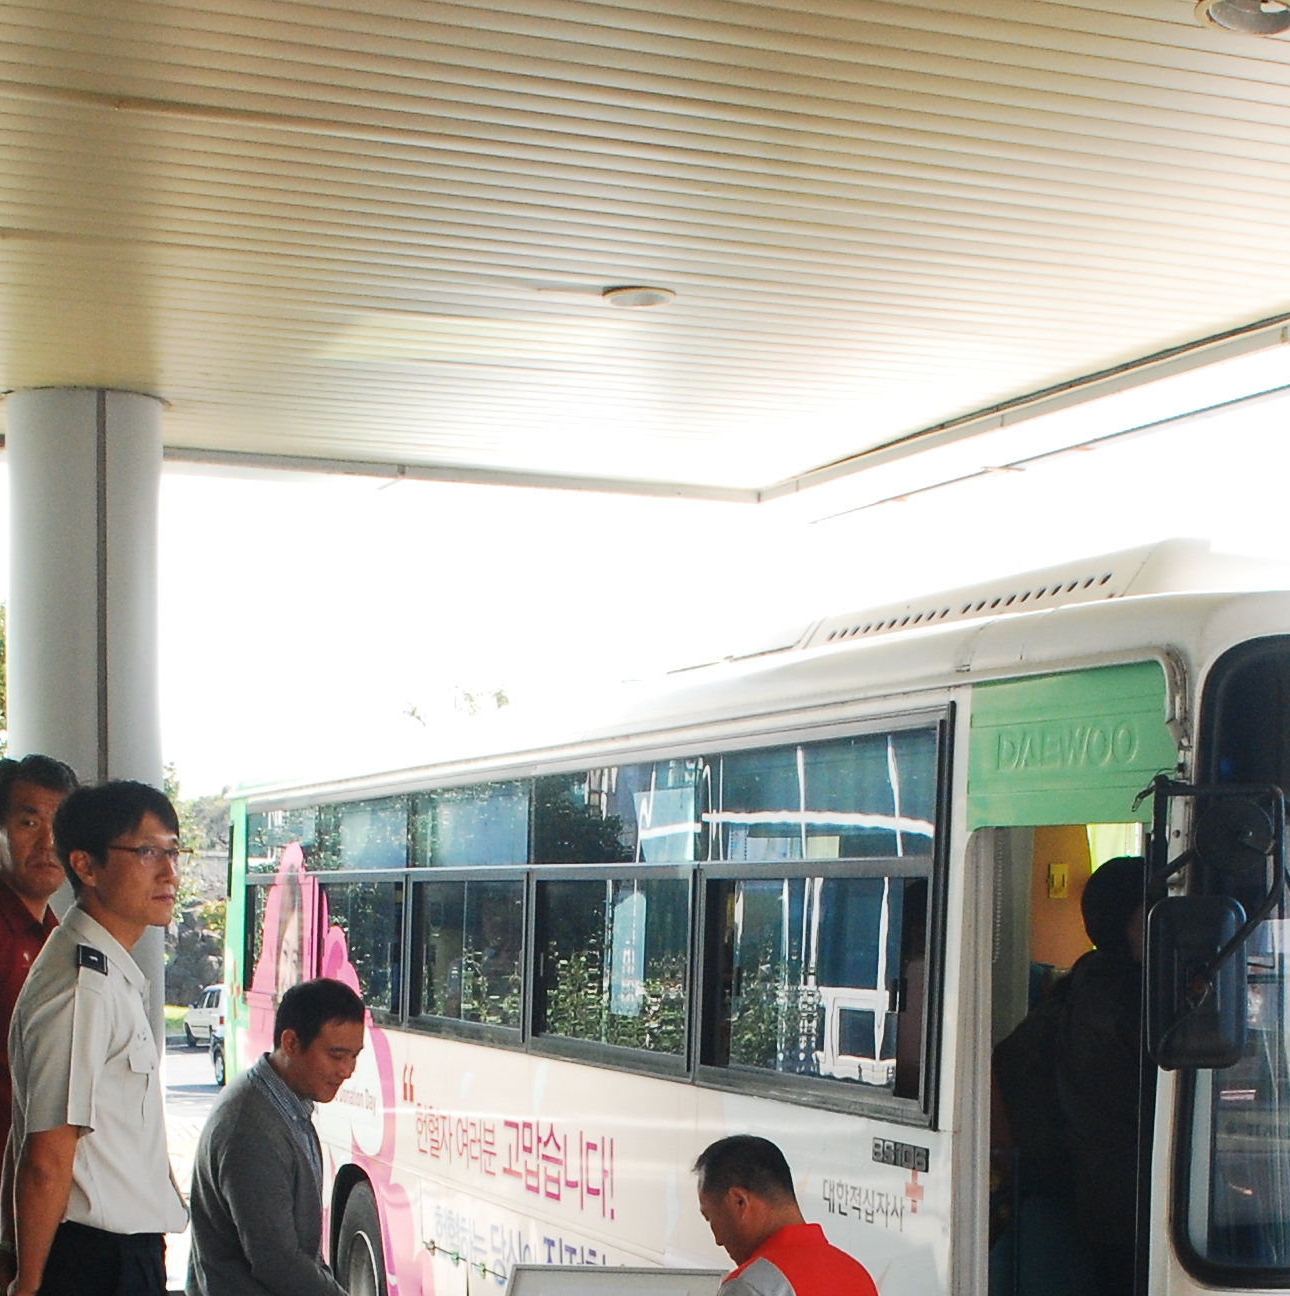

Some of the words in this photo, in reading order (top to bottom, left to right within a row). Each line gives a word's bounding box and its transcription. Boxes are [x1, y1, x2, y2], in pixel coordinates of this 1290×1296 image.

[995, 718, 1139, 771] DAEWOO
[456, 1115, 497, 1176] 여러분
[502, 1119, 615, 1220] 고맙습니다!
[822, 1178, 904, 1232] 대한적십자사
